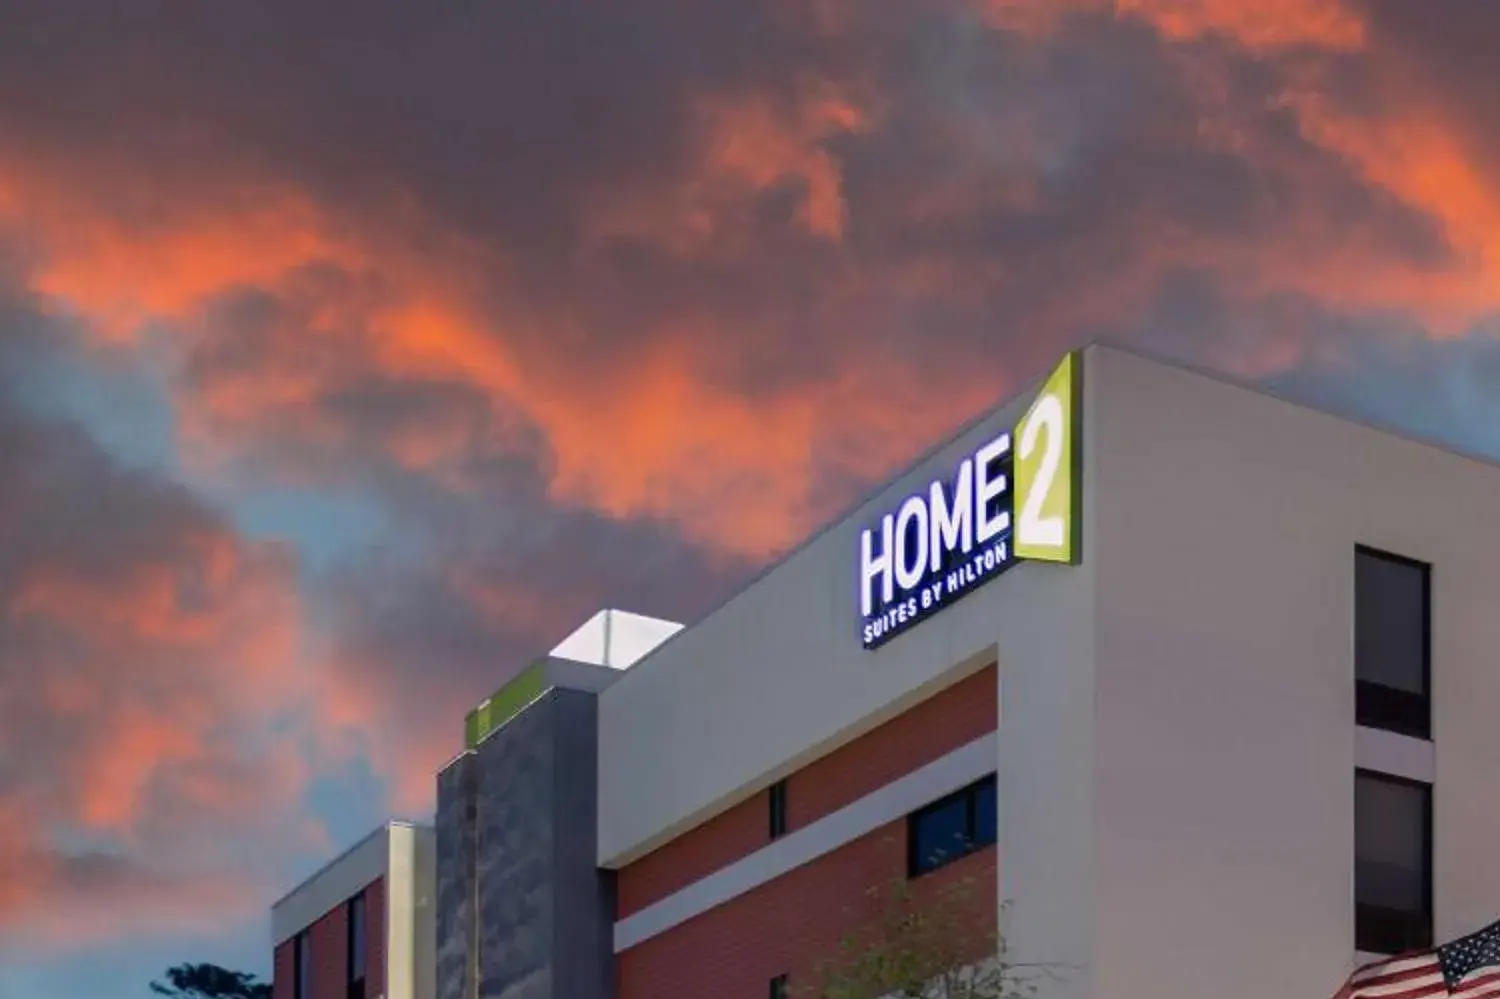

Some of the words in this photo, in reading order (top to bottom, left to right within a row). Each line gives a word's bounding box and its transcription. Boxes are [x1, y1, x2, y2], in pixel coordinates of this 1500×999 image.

[864, 598, 917, 643] SUITES
[921, 581, 942, 609] BY
[947, 541, 1007, 593] HILTON
